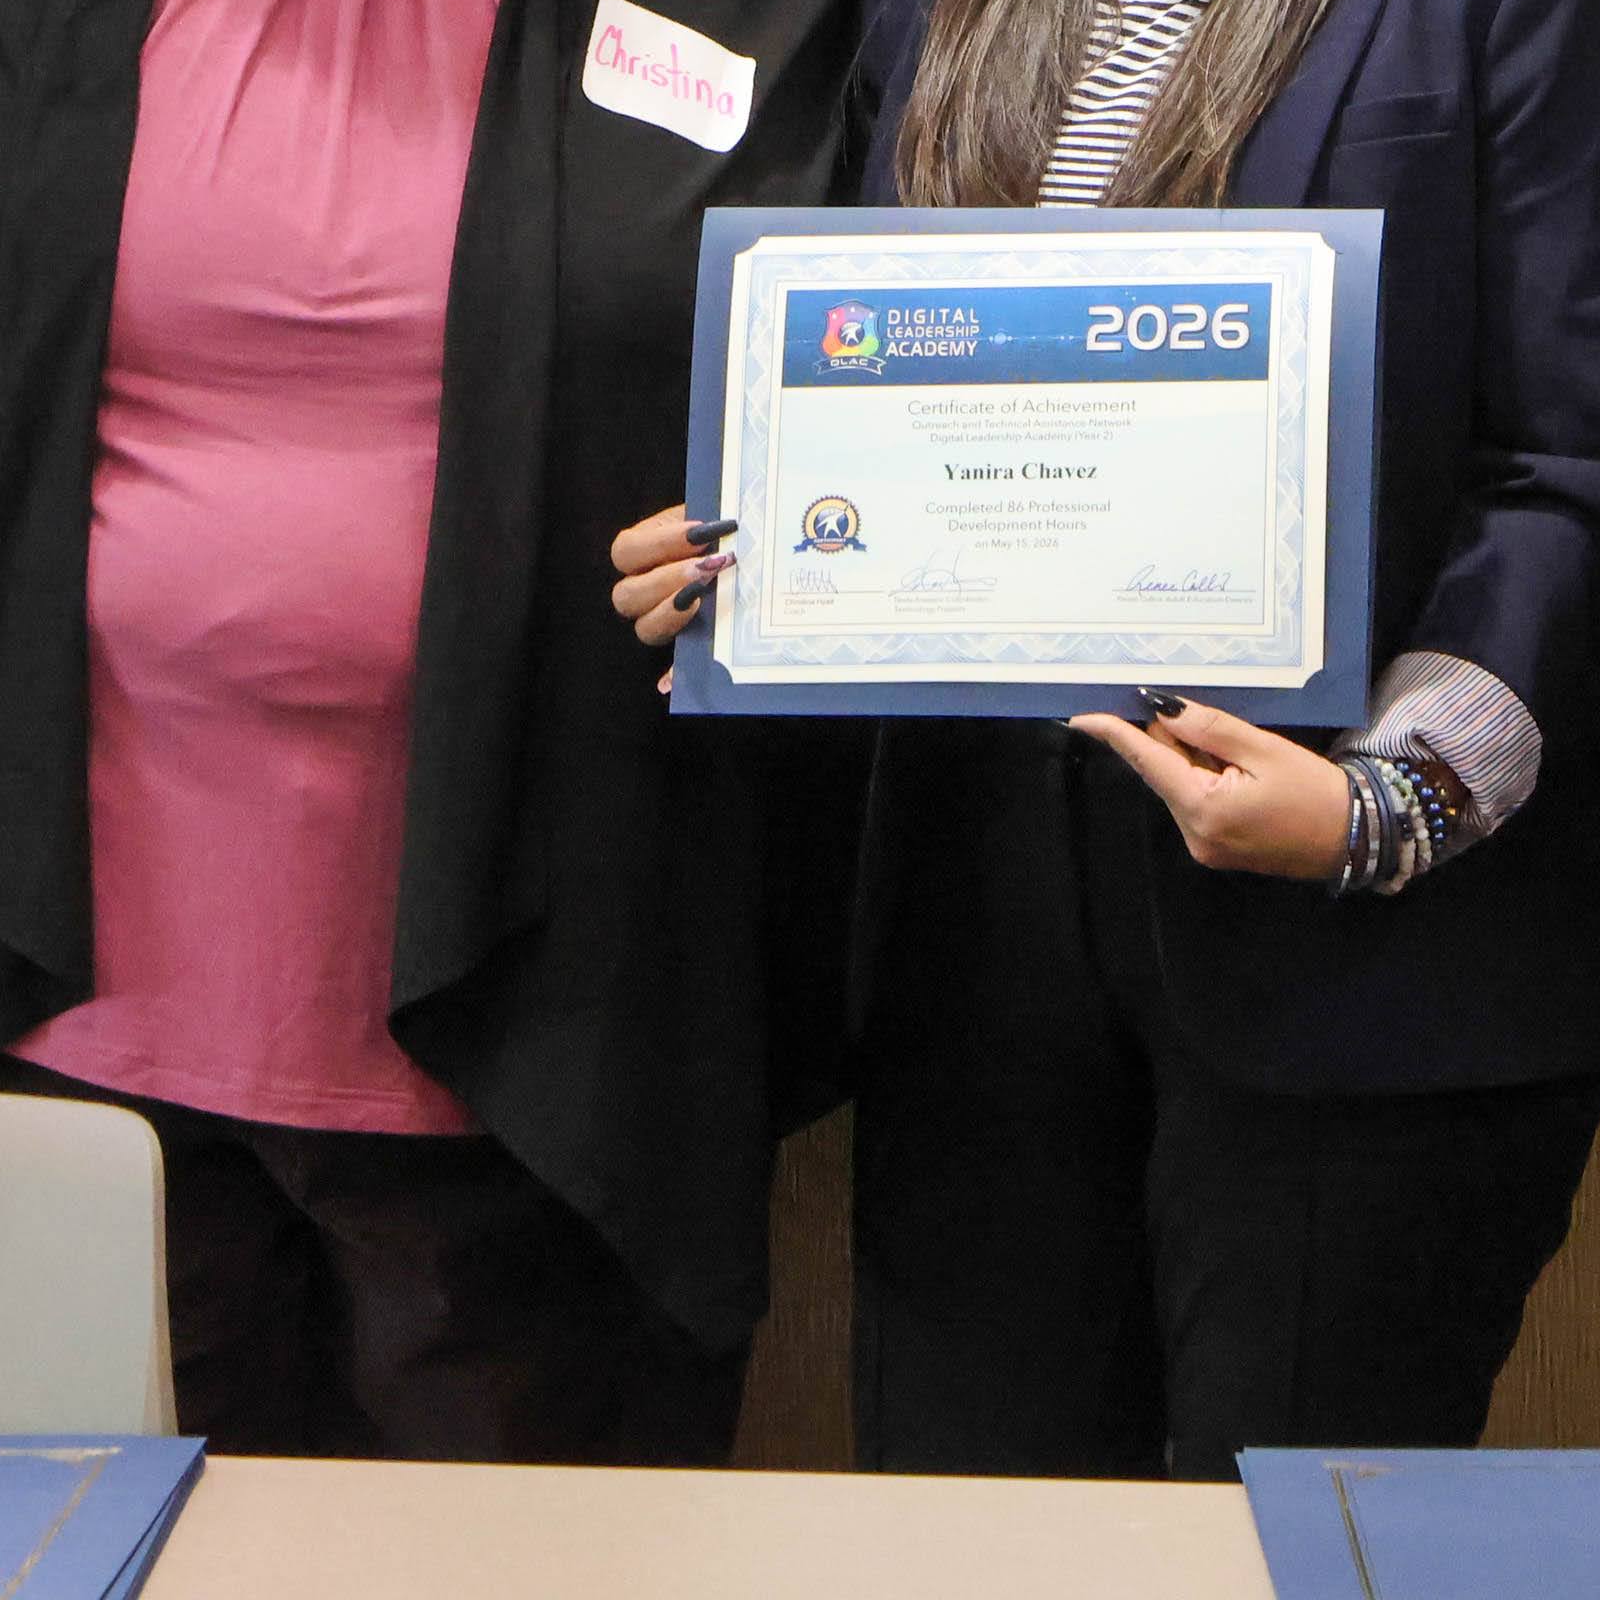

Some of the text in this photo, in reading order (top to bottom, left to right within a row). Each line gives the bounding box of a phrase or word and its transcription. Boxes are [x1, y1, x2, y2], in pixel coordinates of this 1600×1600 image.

[595, 25, 736, 119] Christina
[888, 308, 979, 325] DIGITAL
[887, 325, 980, 338] LEADERSHIP
[1086, 303, 1250, 352] 2026
[885, 340, 978, 357] ACADEMY
[908, 399, 1137, 416] Certificate of Achievement
[962, 420, 981, 429] and
[1089, 418, 1131, 427] Network
[930, 433, 963, 444] Digital
[966, 433, 1022, 443] Leadership
[1024, 431, 1071, 442] Academy
[944, 462, 1097, 480] Yanira Chavez
[925, 500, 1111, 516] Completed 86 Professional
[948, 519, 1087, 533] Development Hours
[975, 540, 988, 548] on
[991, 539, 1012, 550] May
[1033, 538, 1059, 548] 2026
